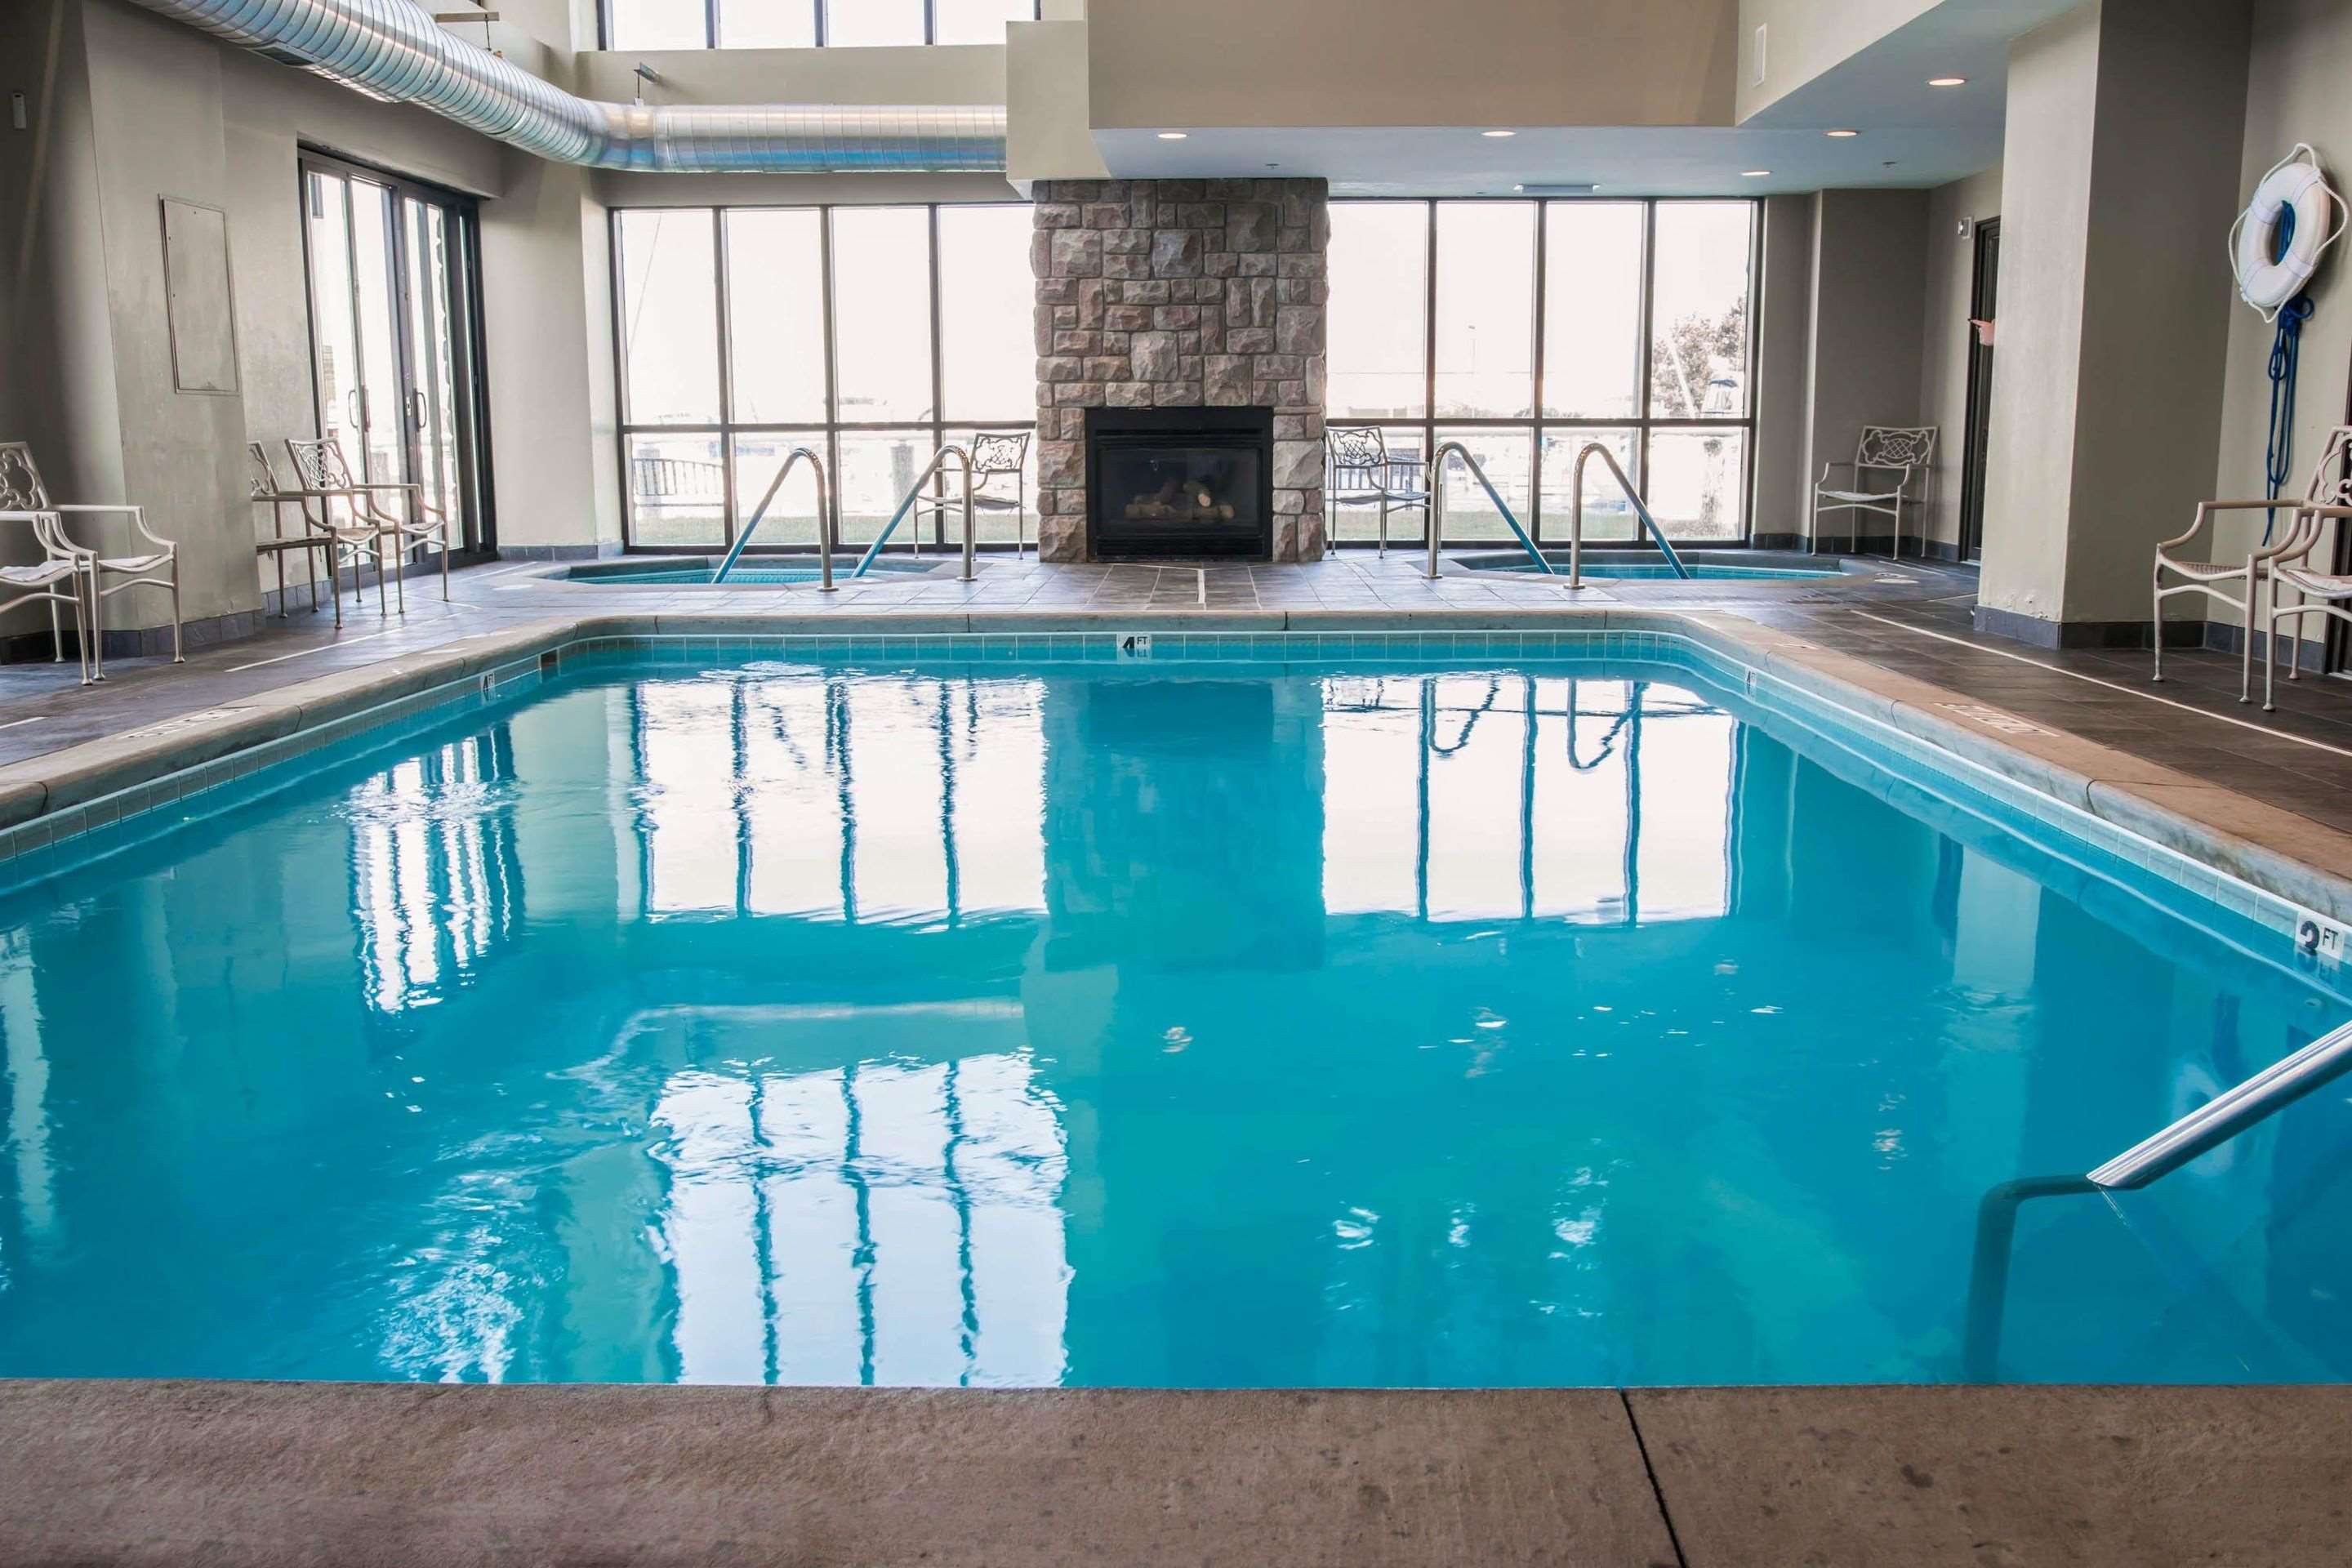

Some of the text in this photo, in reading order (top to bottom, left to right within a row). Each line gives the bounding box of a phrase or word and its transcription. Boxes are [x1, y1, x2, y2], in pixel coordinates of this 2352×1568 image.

[1122, 636, 1147, 648] 4 FT
[2323, 927, 2338, 950] FT
